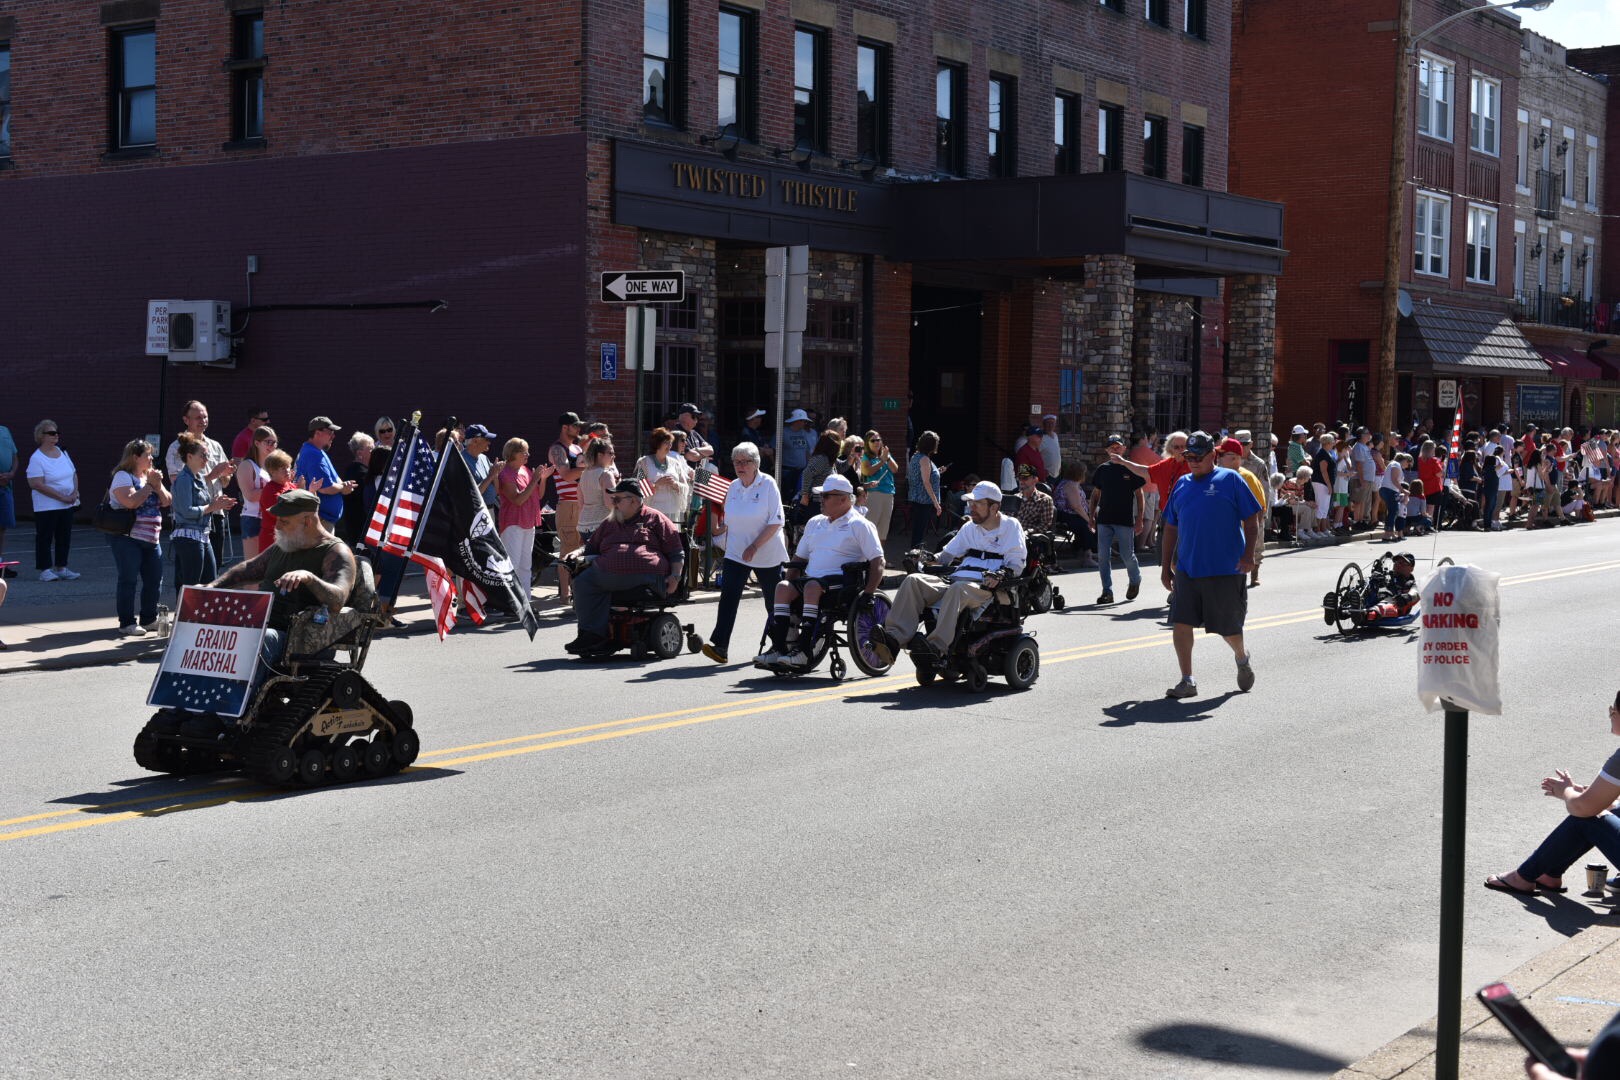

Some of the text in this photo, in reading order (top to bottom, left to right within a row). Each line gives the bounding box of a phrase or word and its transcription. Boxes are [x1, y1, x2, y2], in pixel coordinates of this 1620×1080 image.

[672, 162, 858, 211] TWISTED THISTLE
[626, 281, 674, 293] ONE WAY
[155, 307, 168, 315] PER
[152, 316, 168, 325] PARK
[157, 326, 168, 334] ONL
[1433, 592, 1454, 607] NO
[1422, 613, 1478, 629] ARKING
[195, 628, 238, 650] GRAND
[1435, 642, 1468, 651] ORDER
[180, 649, 237, 674] MARSHAL
[1435, 655, 1470, 664] POLICE
